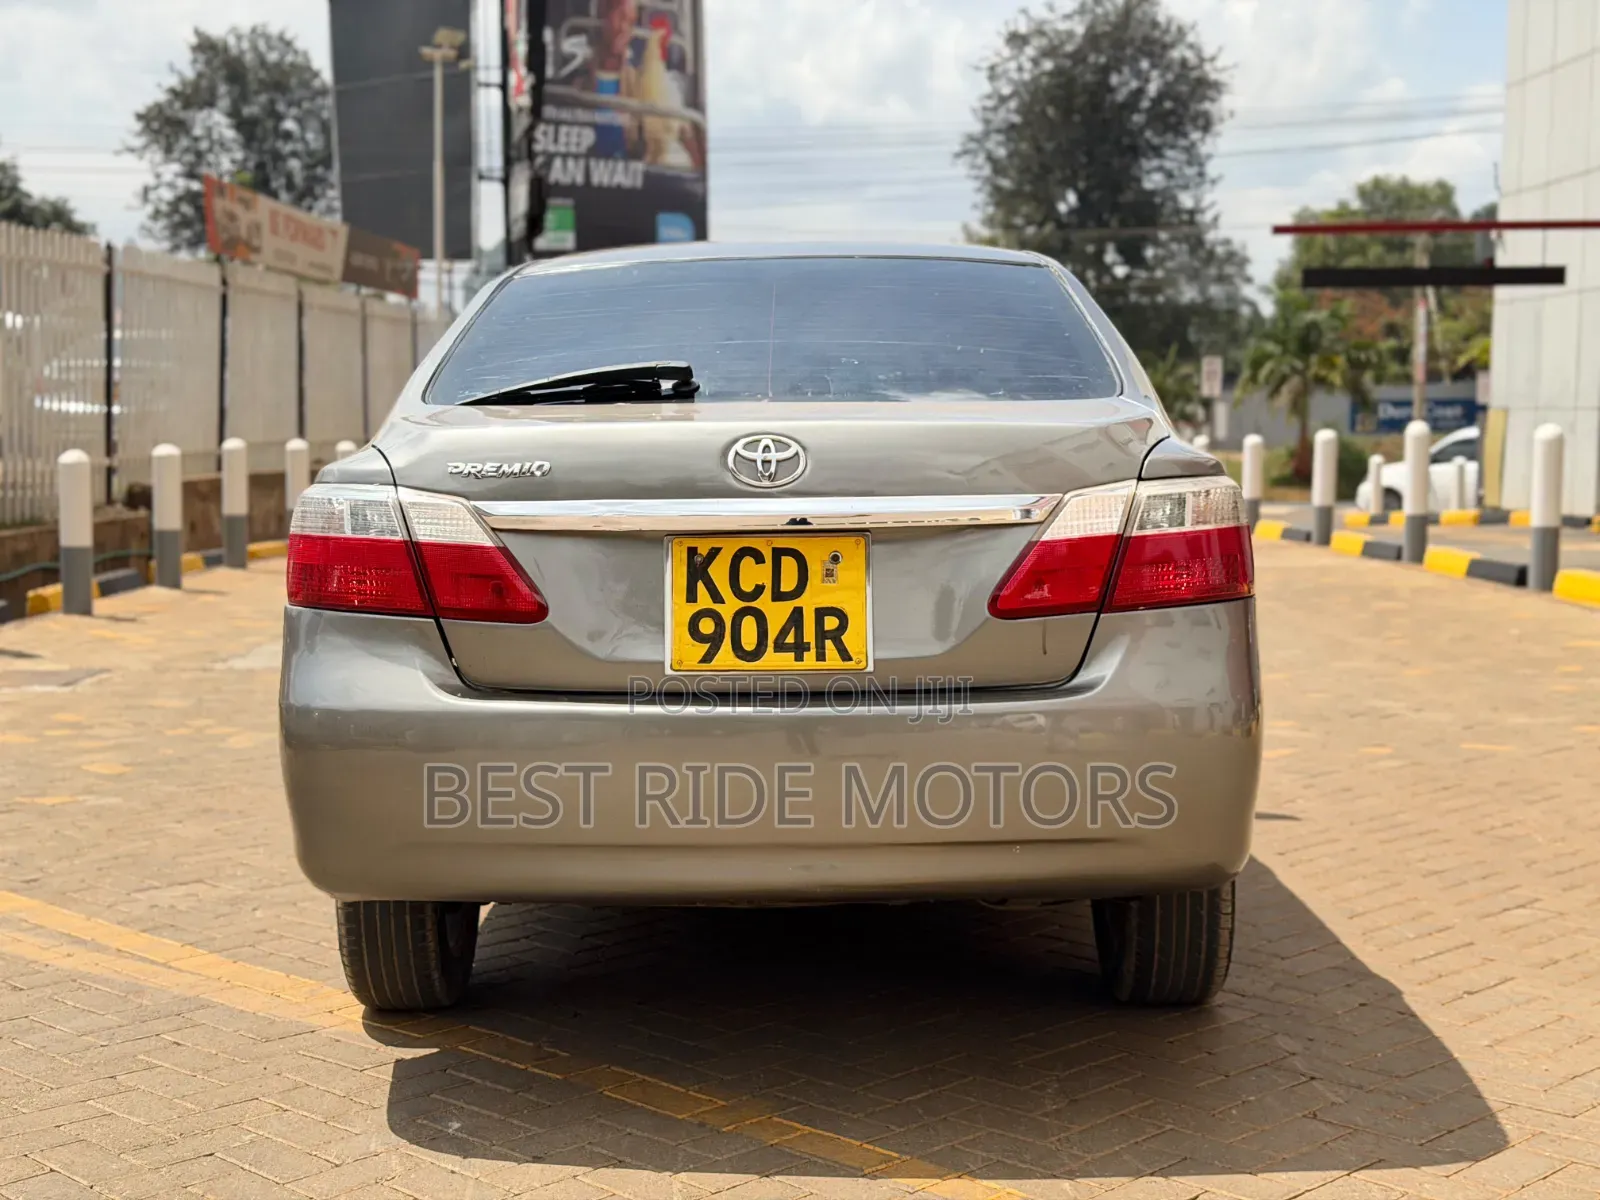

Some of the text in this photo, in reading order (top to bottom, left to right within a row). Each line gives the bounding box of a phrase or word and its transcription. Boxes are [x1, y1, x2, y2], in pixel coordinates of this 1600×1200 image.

[531, 122, 597, 154] SLEEP
[589, 157, 646, 190] WAIT
[447, 461, 551, 478] PREMIO
[685, 546, 809, 604] KCD
[687, 605, 853, 664] 904R
